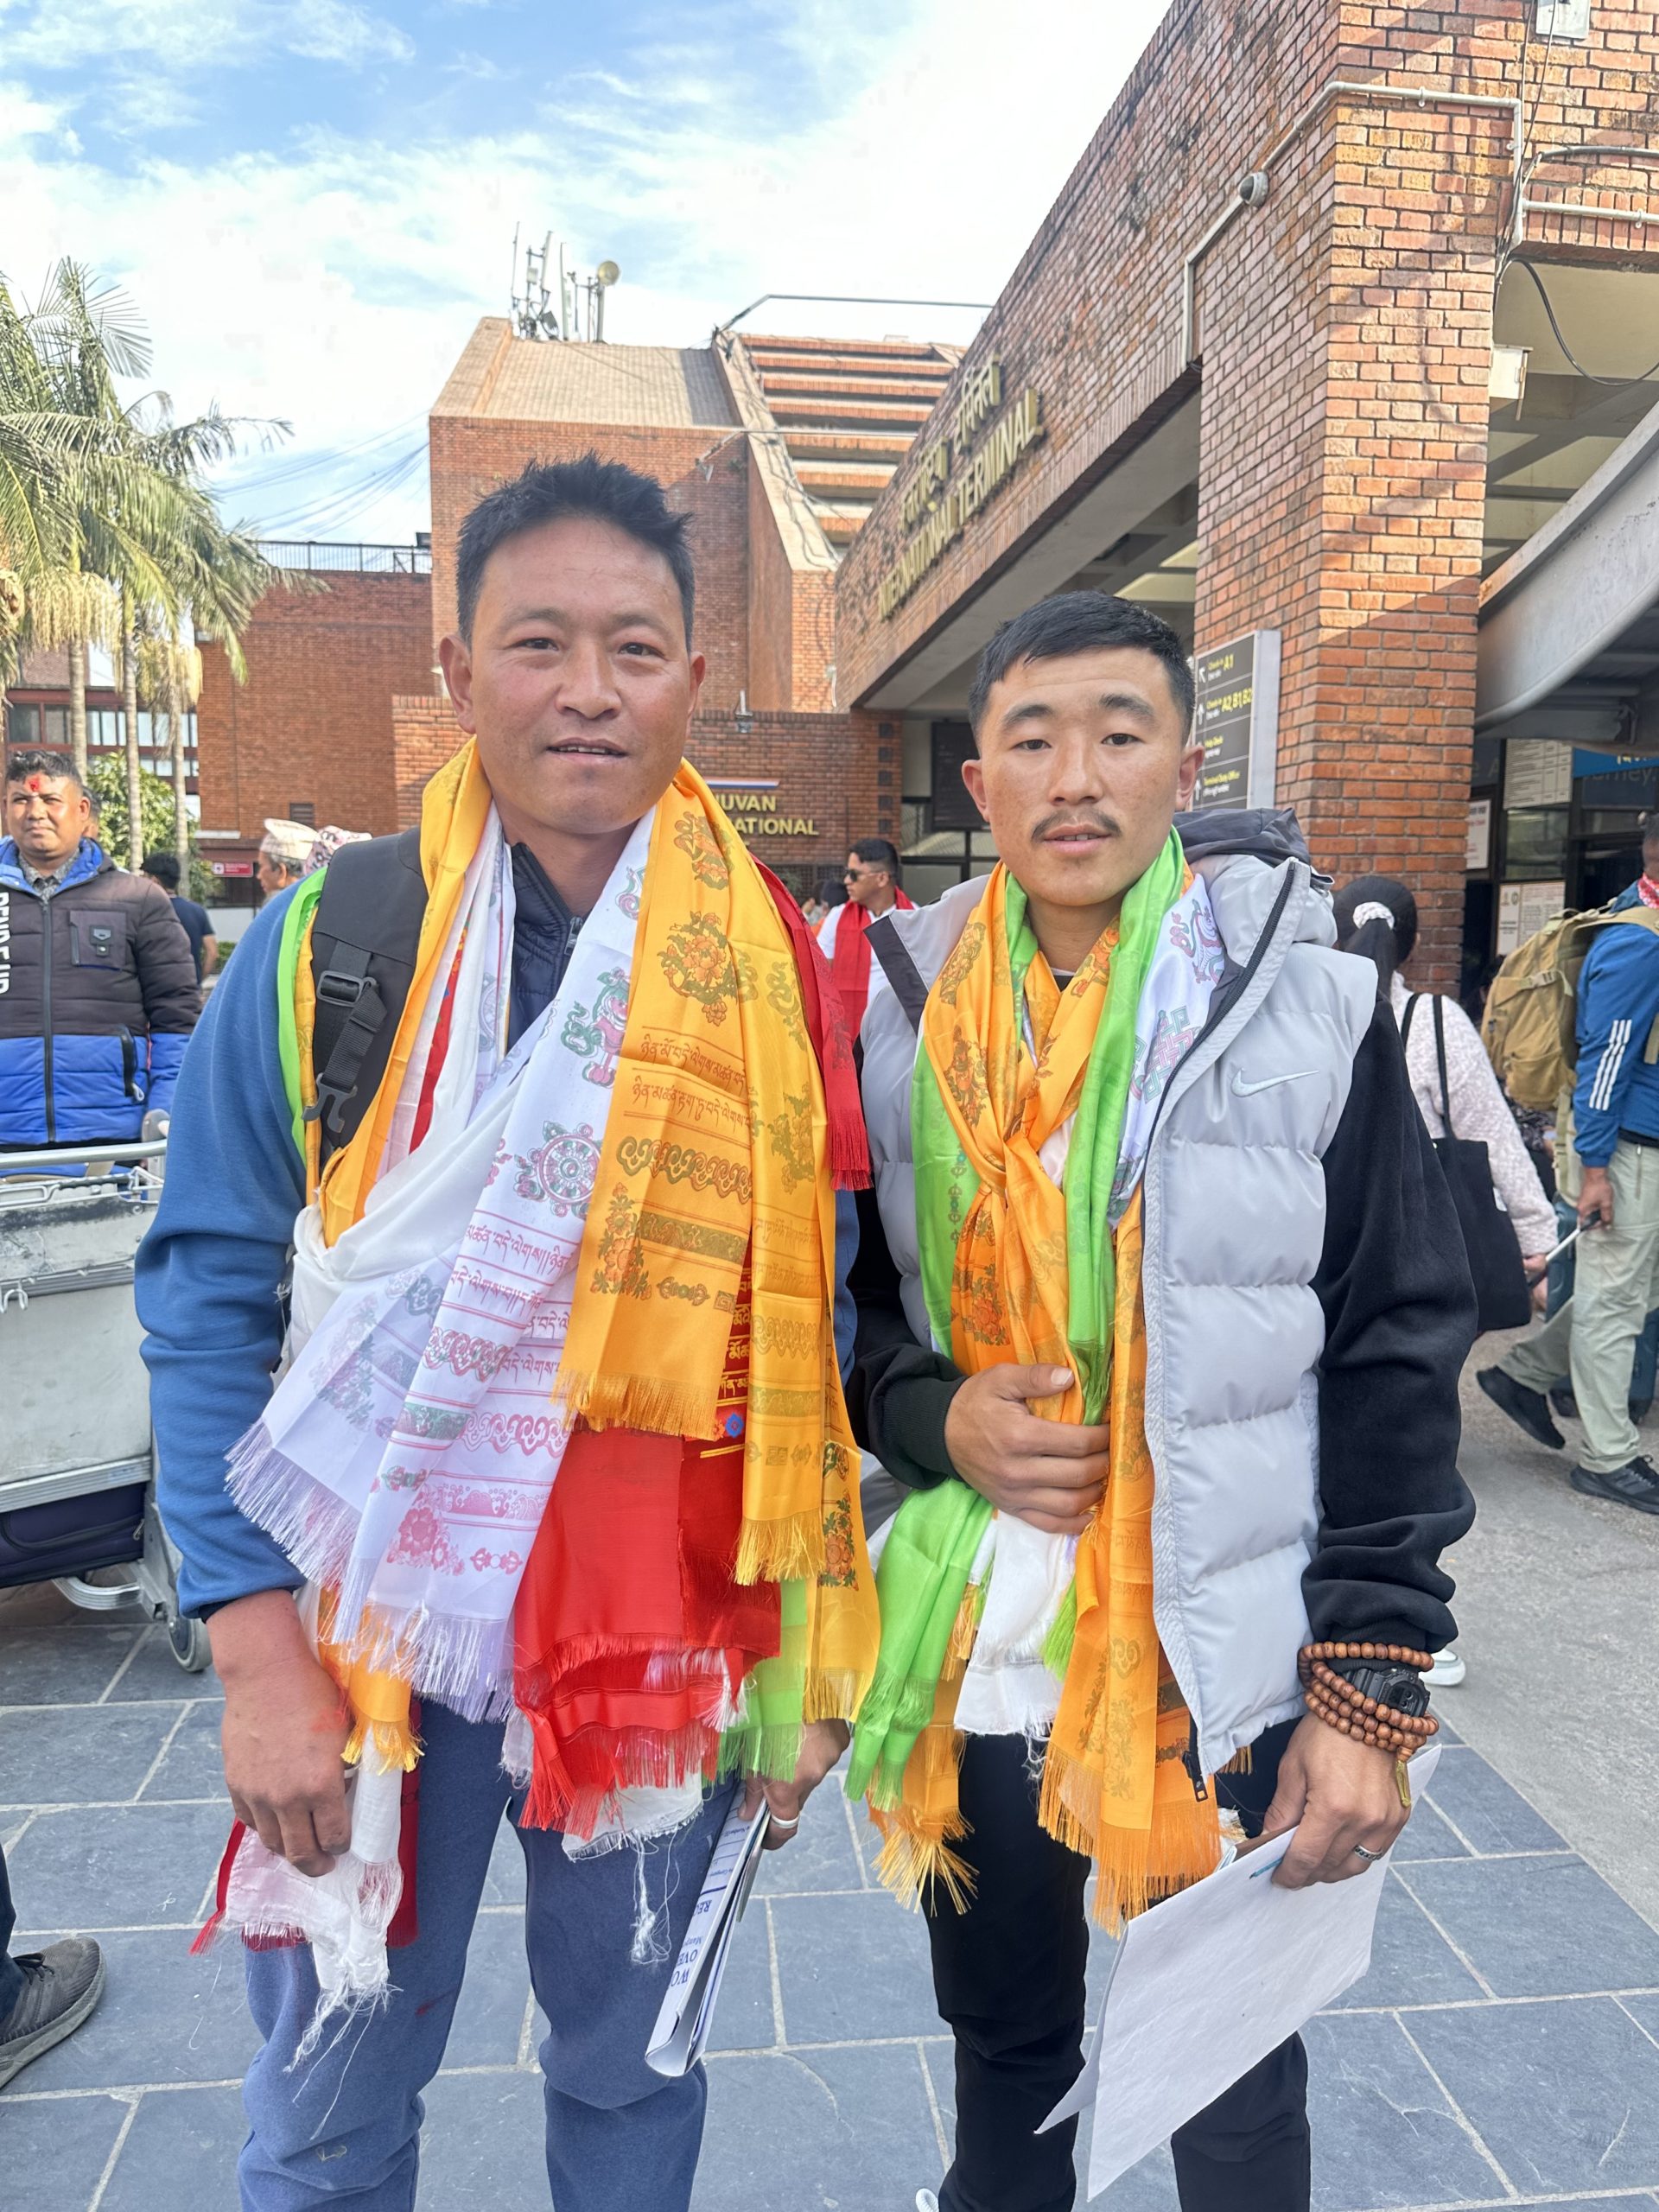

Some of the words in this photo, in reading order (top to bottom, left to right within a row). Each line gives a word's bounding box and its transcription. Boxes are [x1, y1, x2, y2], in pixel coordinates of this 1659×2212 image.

[957, 388, 1042, 524] TERMINAL
[716, 794, 777, 811] UVAN
[732, 817, 819, 836] ATIONAL
